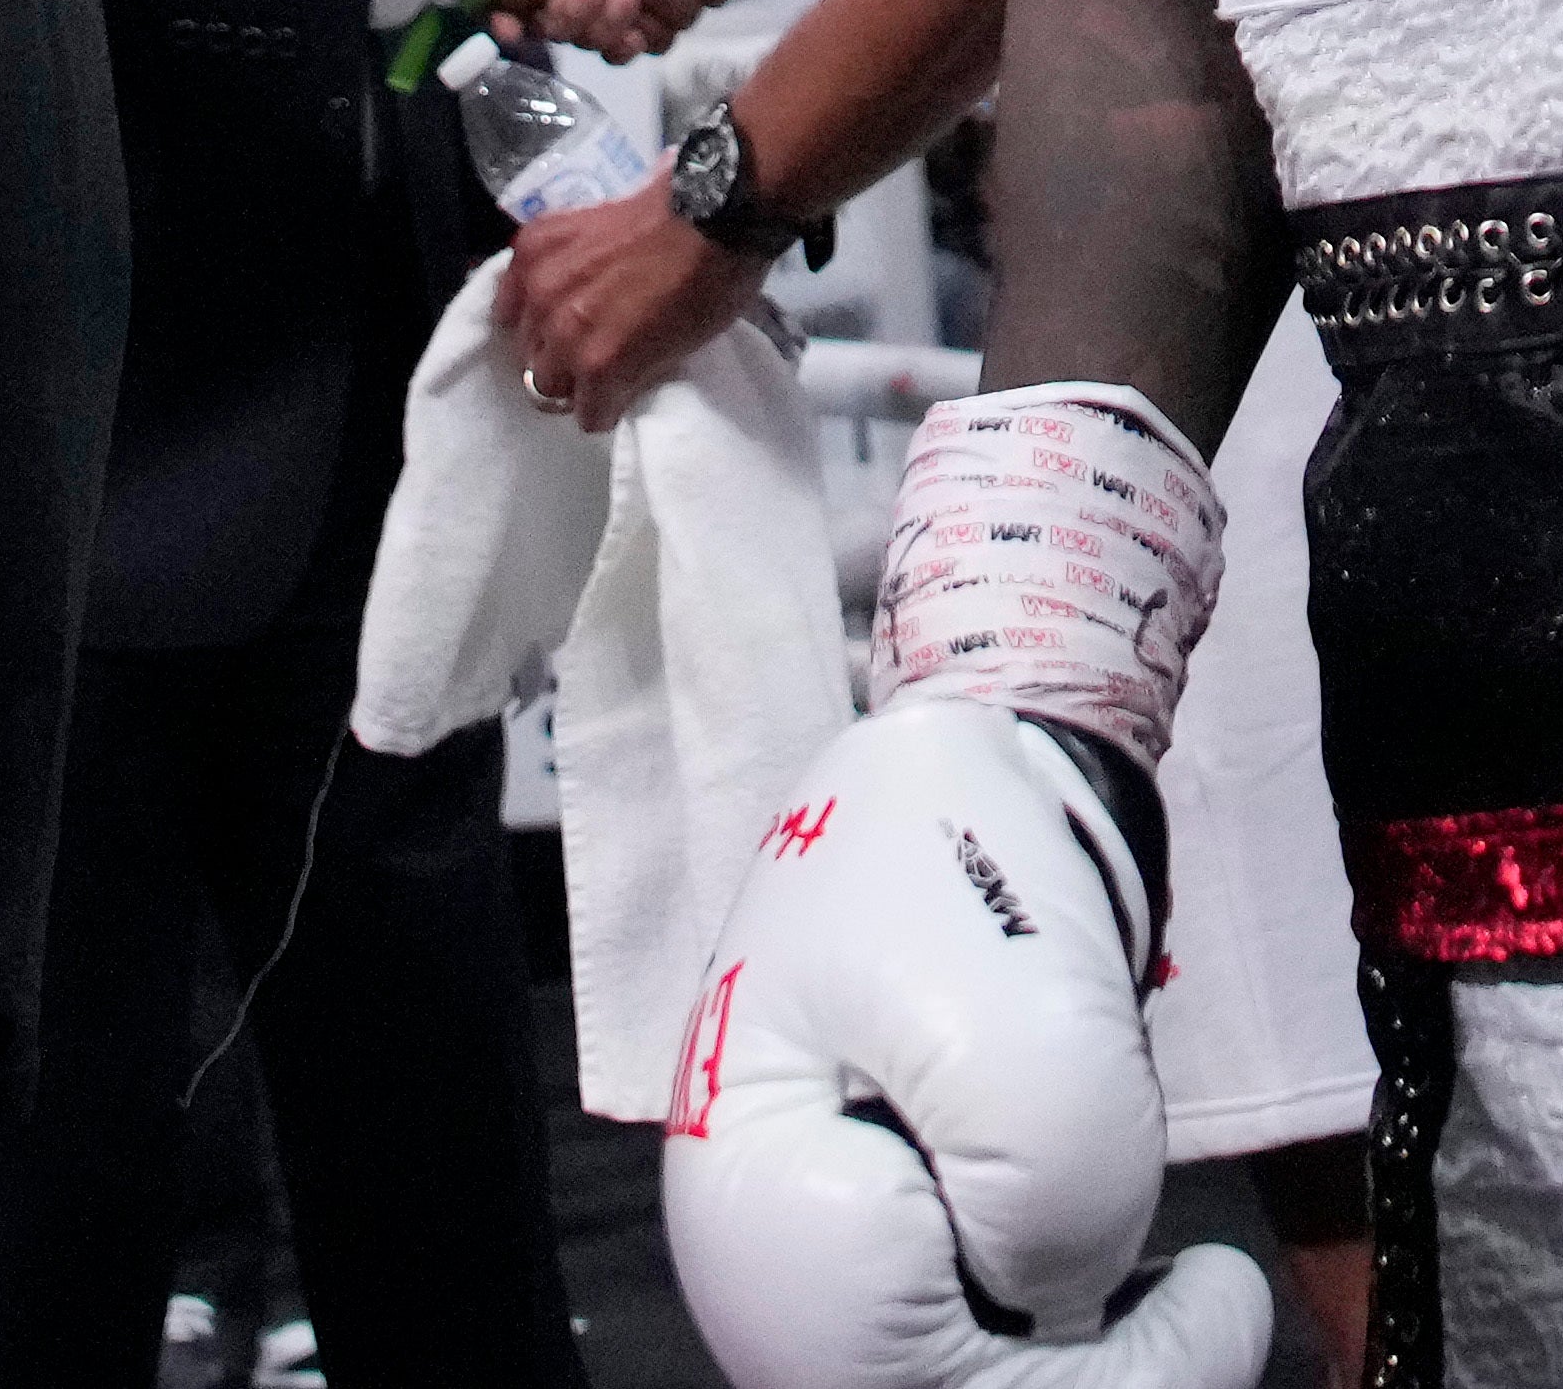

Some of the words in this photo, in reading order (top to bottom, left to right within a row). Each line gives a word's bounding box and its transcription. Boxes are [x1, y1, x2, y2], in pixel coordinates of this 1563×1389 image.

[1092, 466, 1136, 504] WAR
[989, 523, 1043, 542] WAR
[948, 629, 999, 655] WAR
